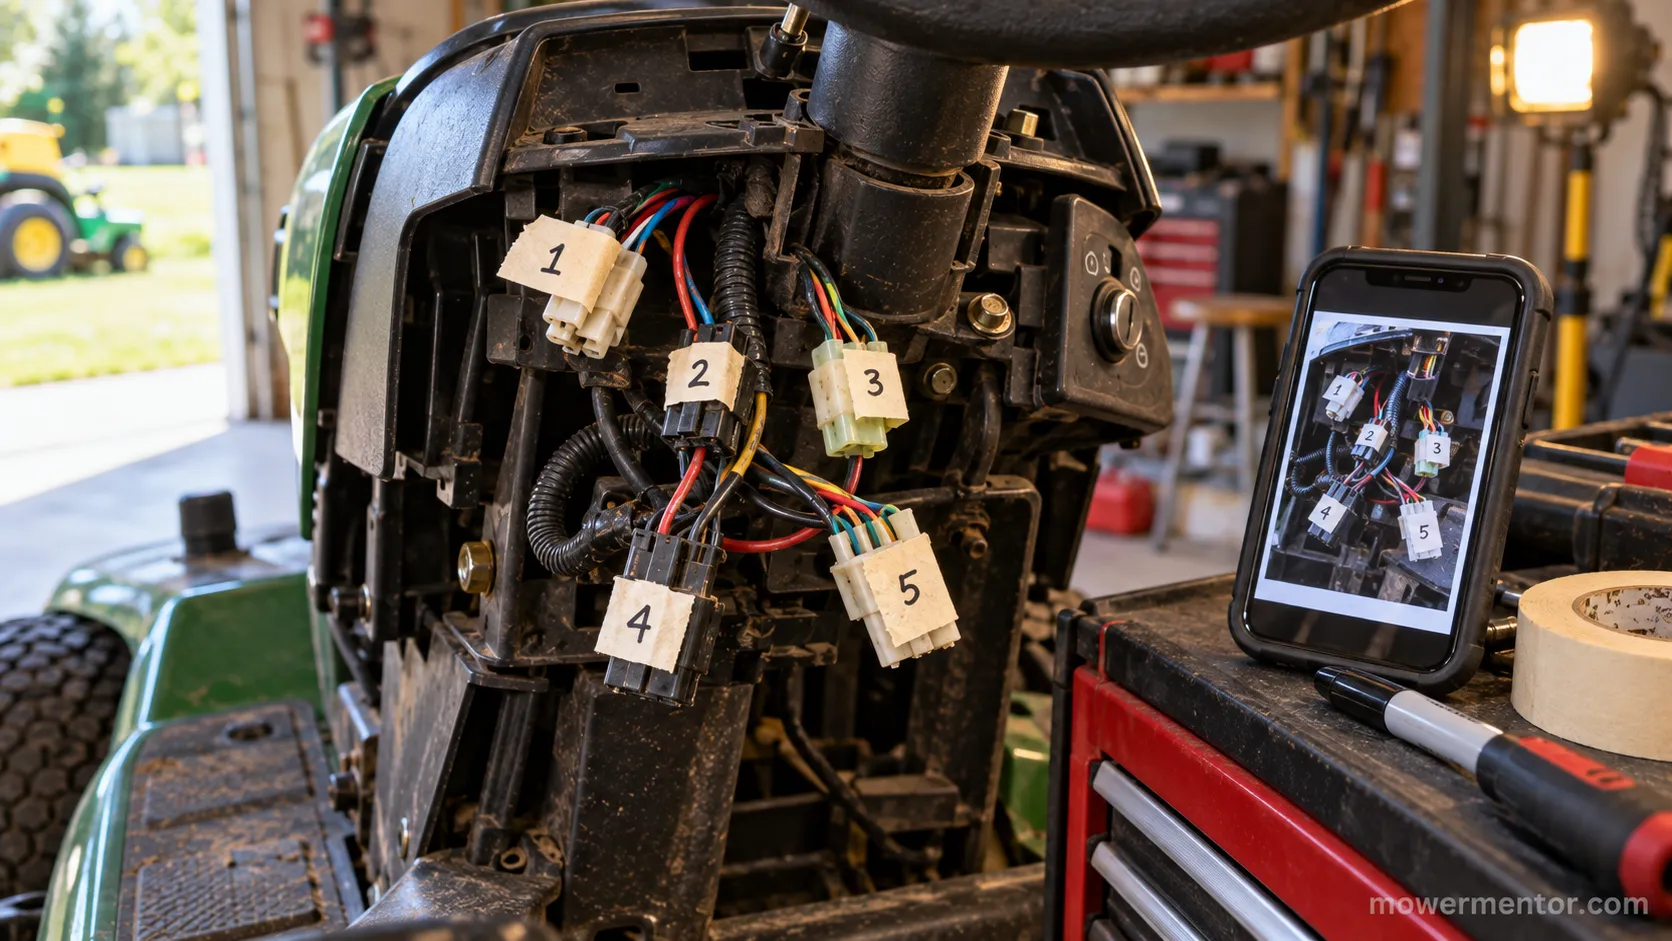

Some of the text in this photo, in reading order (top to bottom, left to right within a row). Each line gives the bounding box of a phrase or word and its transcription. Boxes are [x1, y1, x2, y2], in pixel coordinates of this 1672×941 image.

[541, 243, 565, 276] 1
[687, 358, 710, 389] 2
[863, 368, 884, 397] 3
[1333, 384, 1343, 396] 1
[1364, 430, 1375, 442] 2
[1433, 442, 1442, 455] 3
[1320, 505, 1332, 521] 4
[1419, 524, 1430, 540] 5
[898, 568, 921, 606] 5
[626, 605, 652, 644] 4
